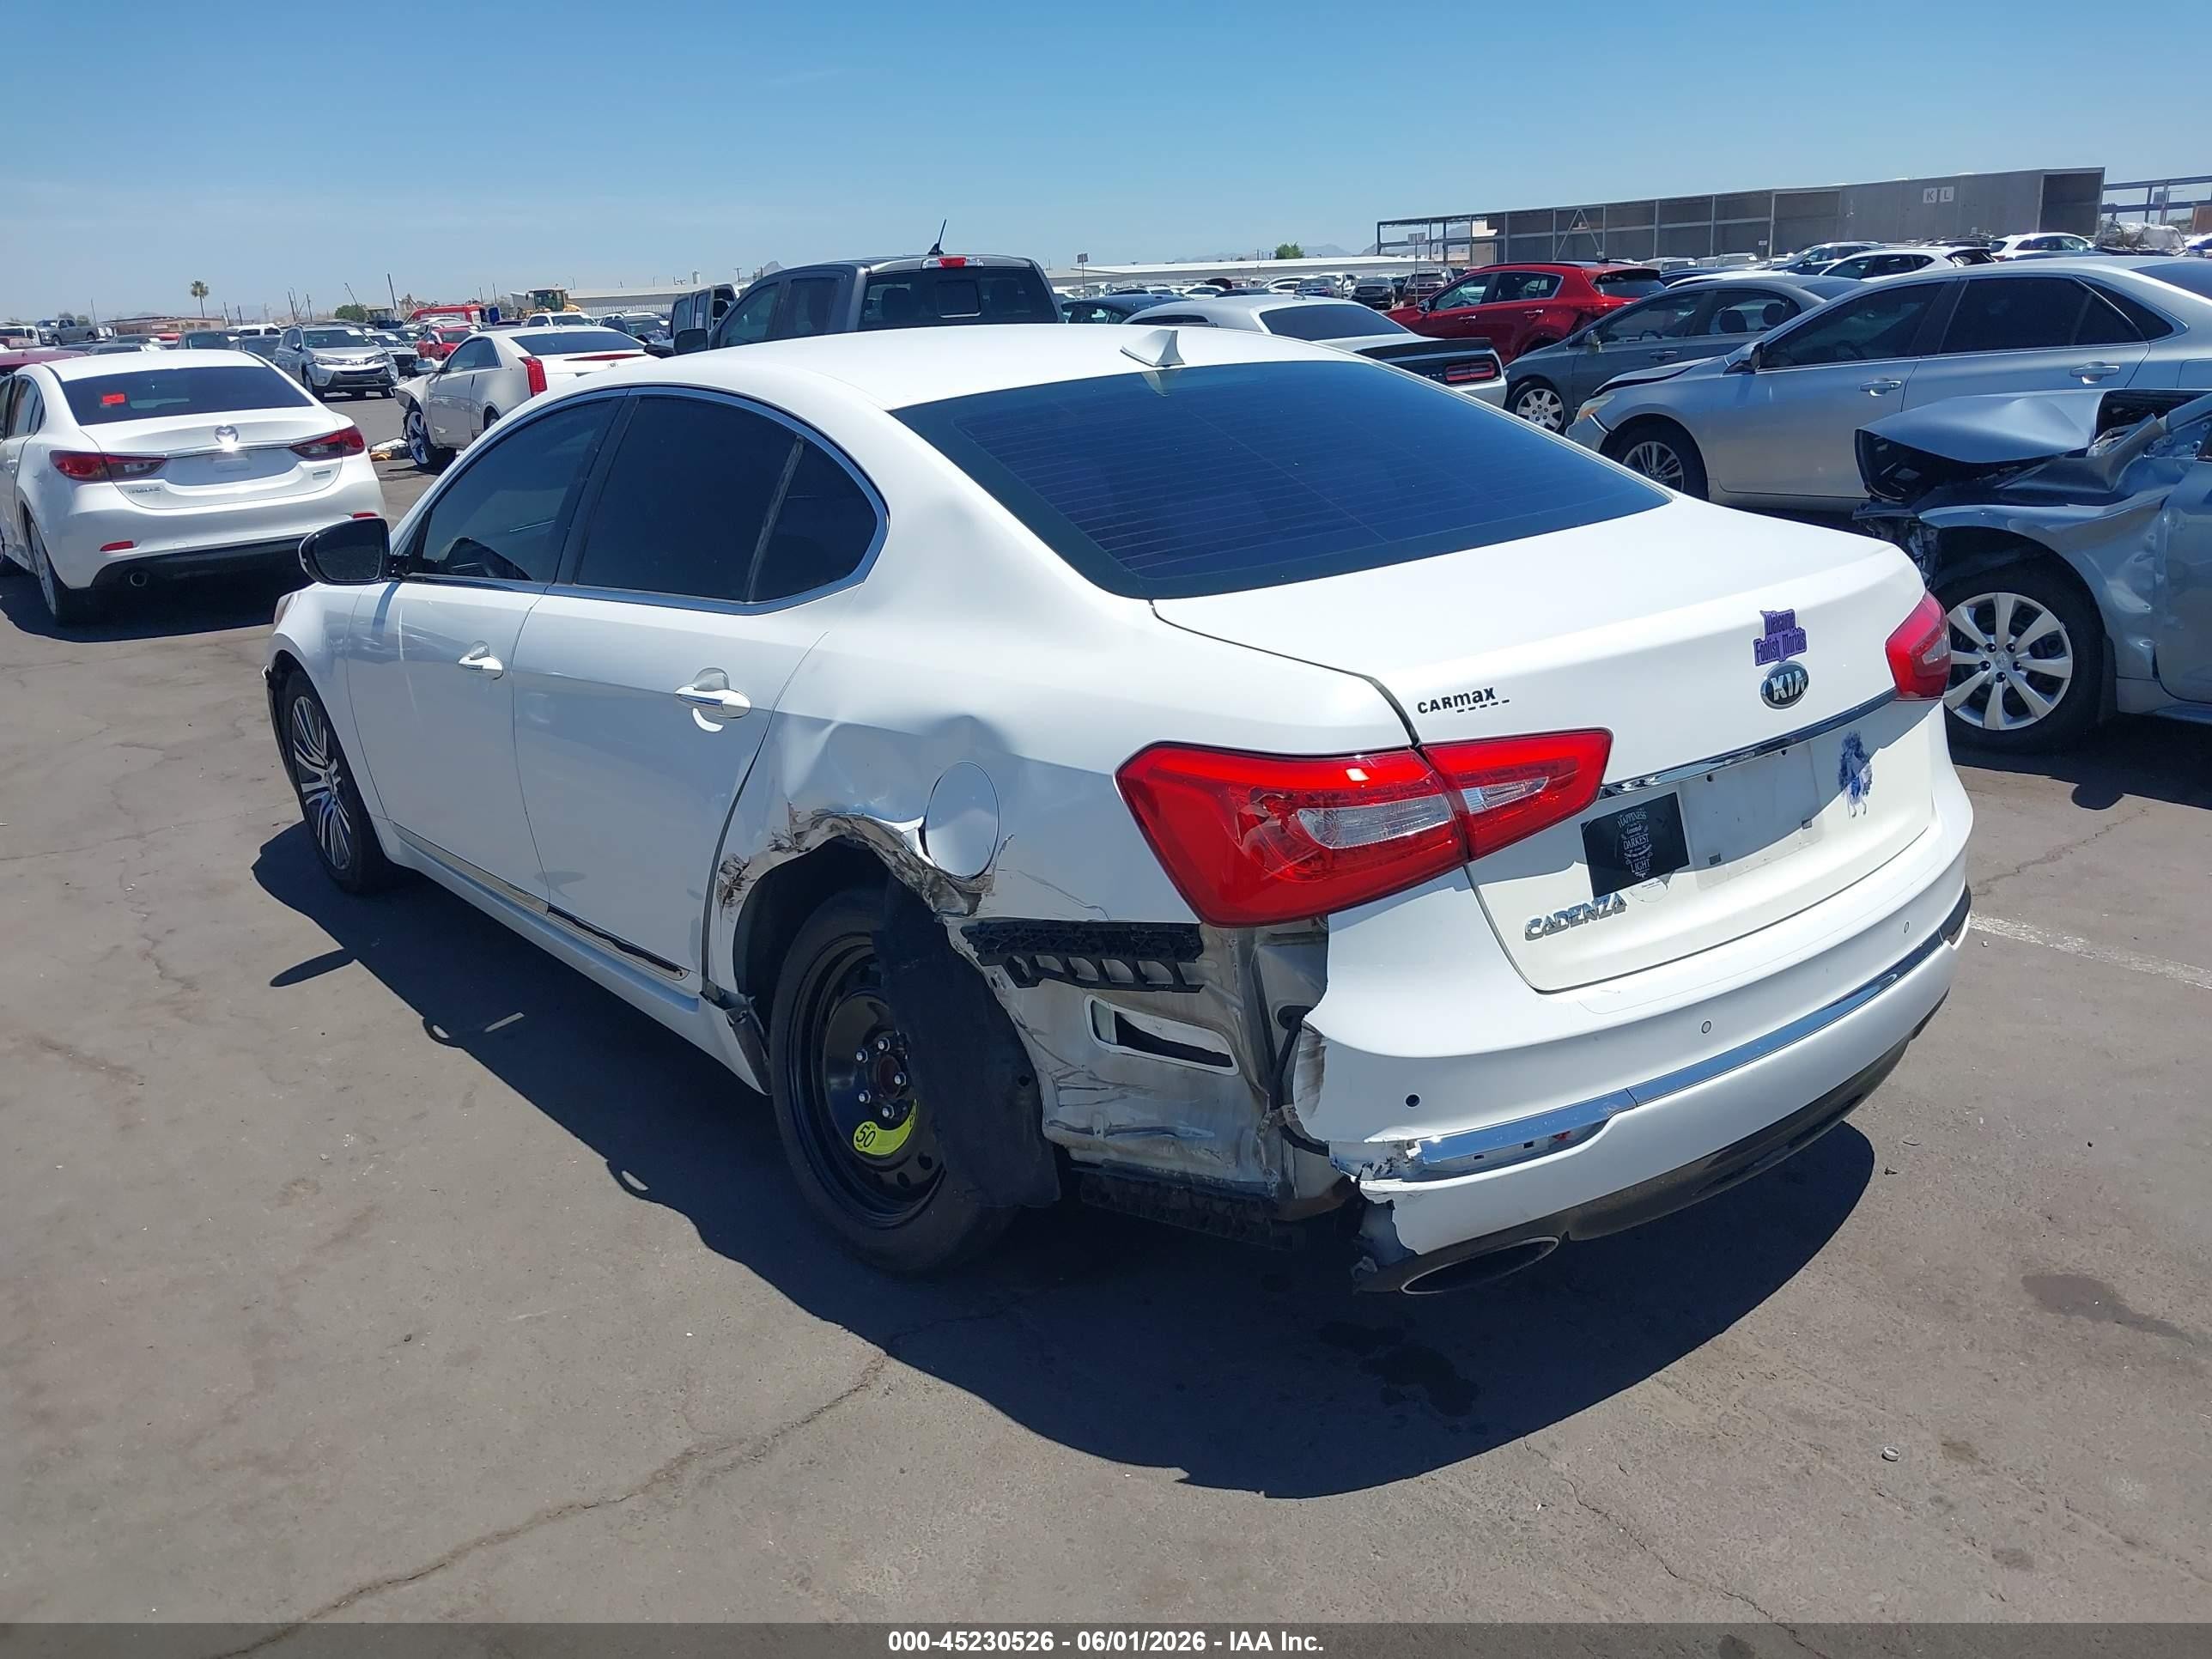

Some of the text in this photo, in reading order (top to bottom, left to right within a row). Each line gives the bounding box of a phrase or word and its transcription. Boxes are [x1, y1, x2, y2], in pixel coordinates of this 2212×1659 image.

[1756, 635, 1780, 663] Foolish
[1771, 670, 1806, 702] KIA
[1623, 833, 1650, 850] DARKEST
[1631, 858, 1650, 873] LIGHT
[1525, 893, 1627, 941] CADENZA
[855, 1124, 876, 1148] 50
